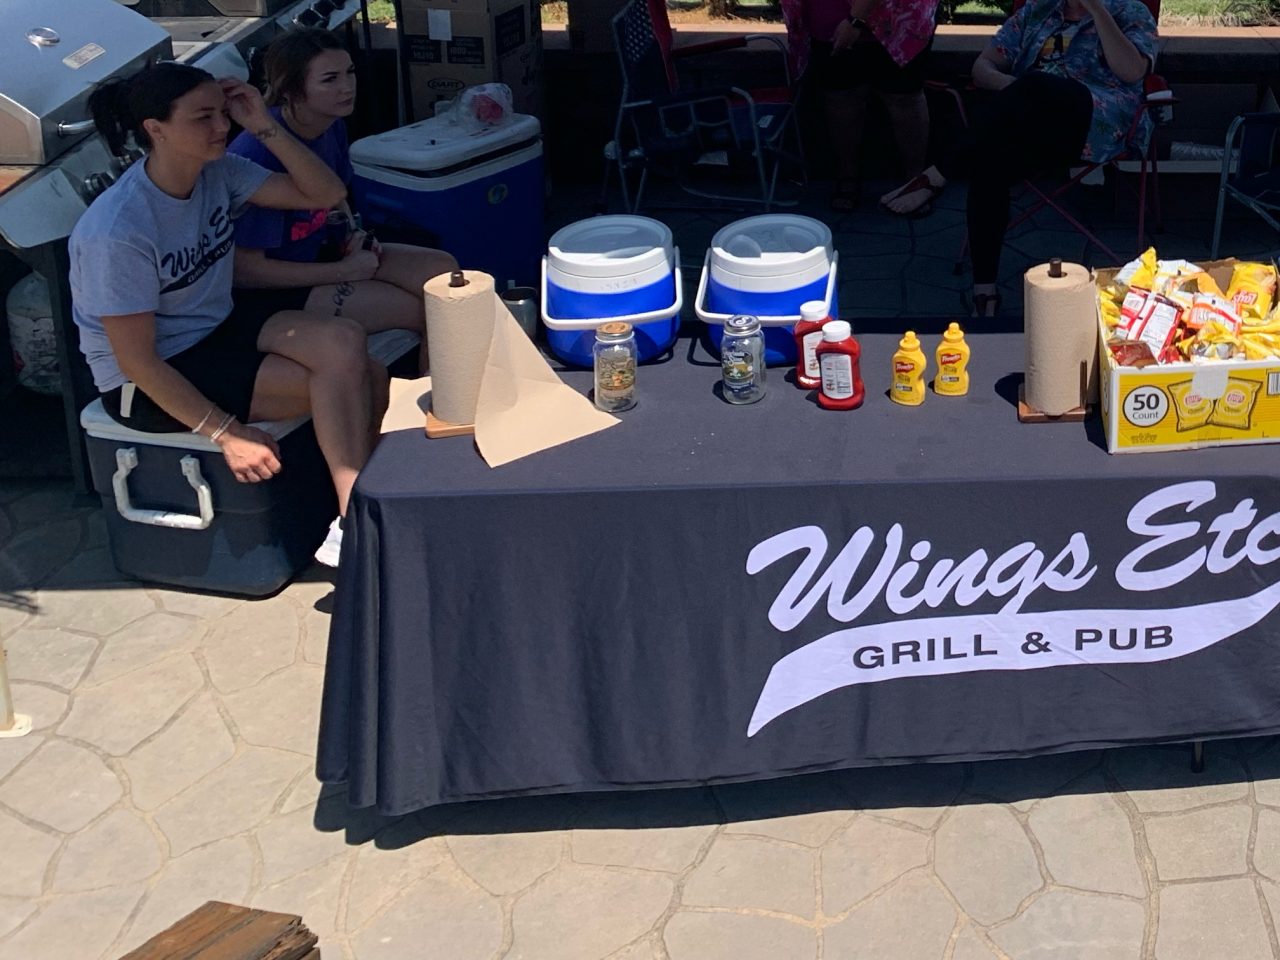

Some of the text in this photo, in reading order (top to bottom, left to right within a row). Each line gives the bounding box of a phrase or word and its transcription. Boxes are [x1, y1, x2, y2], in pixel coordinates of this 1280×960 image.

[1131, 411, 1160, 421] Count
[1132, 393, 1160, 411] 50
[746, 523, 1097, 631] Wings
[852, 625, 1174, 669] GRILL & PUB
